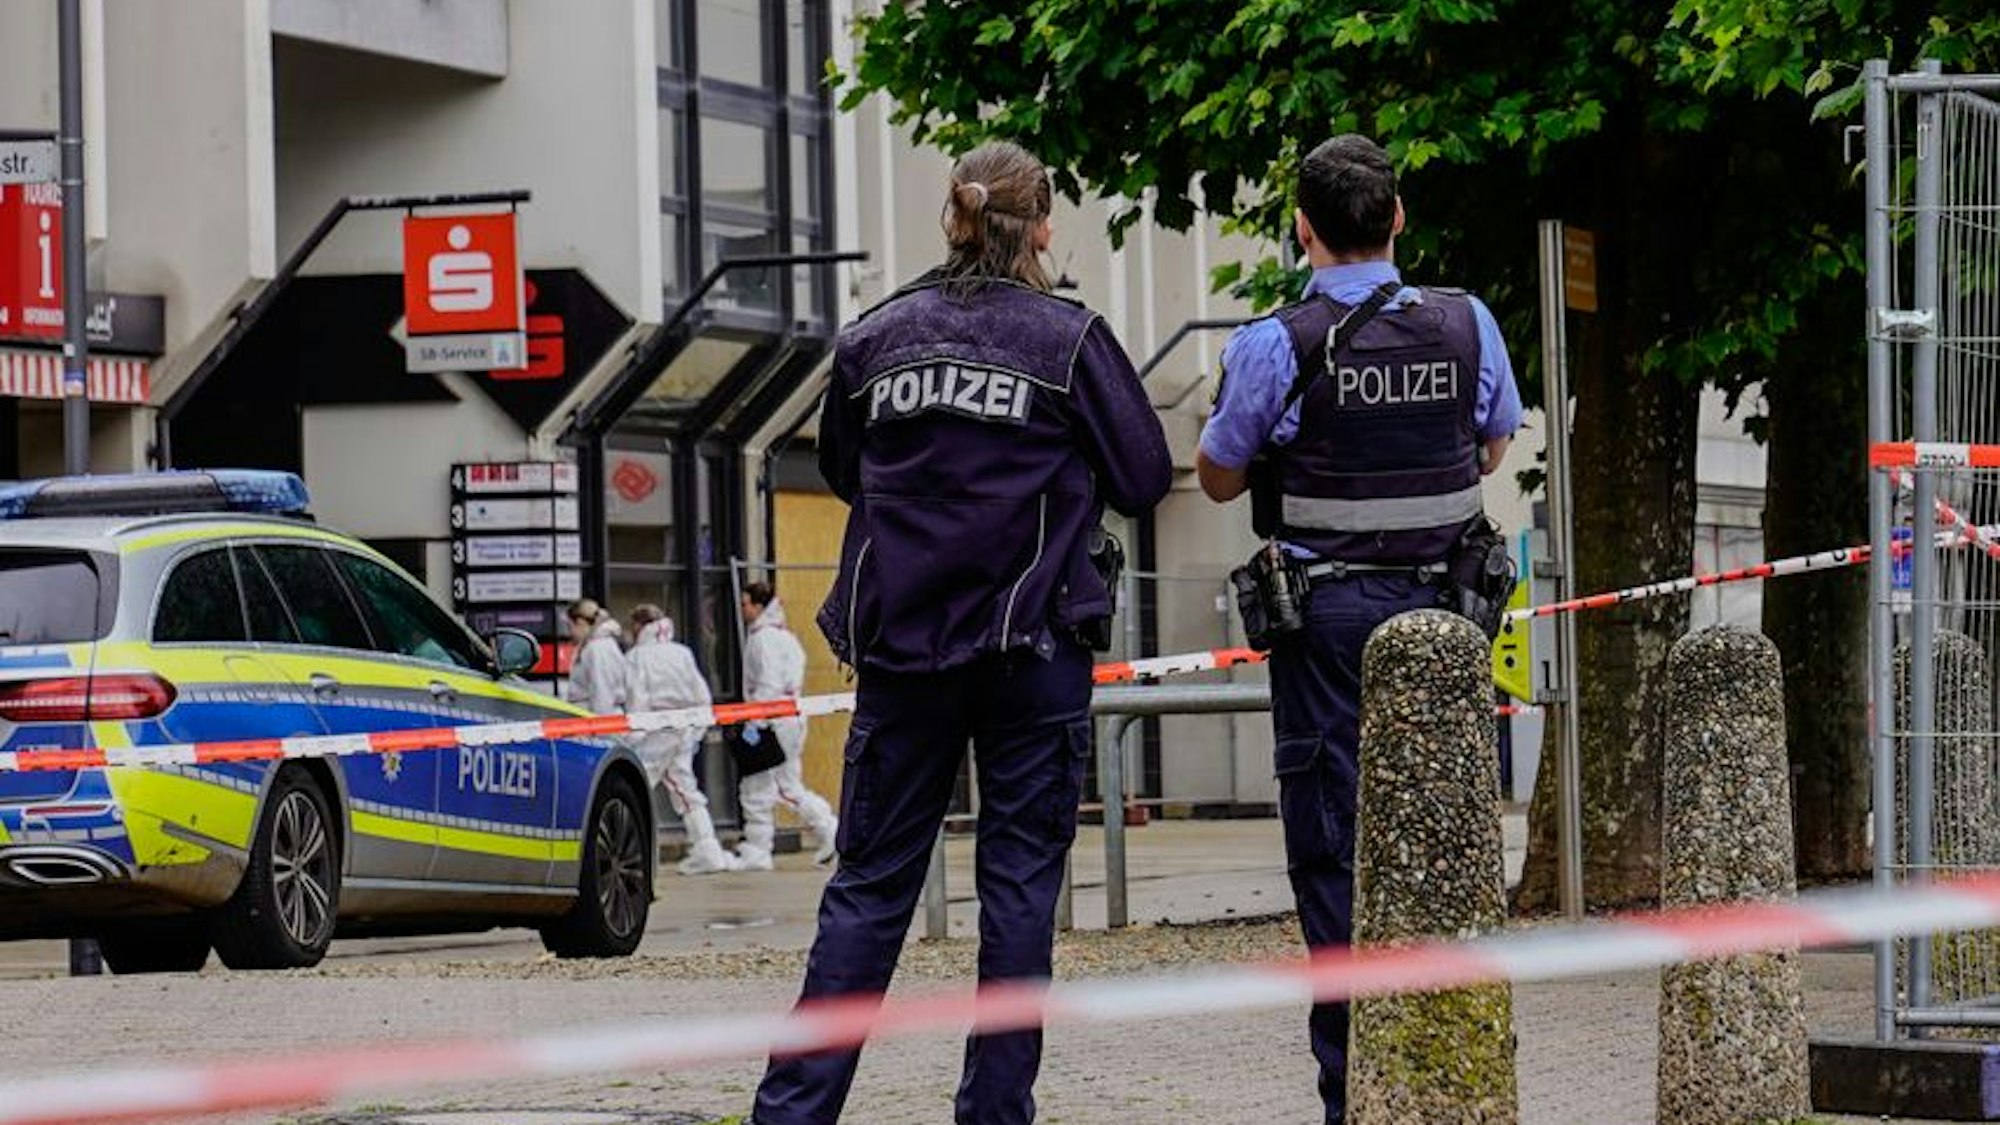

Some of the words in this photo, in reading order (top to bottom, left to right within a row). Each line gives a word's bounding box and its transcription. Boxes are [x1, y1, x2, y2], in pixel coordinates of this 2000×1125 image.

[0, 151, 35, 174] str.
[870, 364, 1030, 421] POLIZEI
[1337, 361, 1458, 406] POLIZEI
[452, 468, 463, 491] 4
[452, 504, 464, 528] 3
[453, 540, 465, 563] 3
[453, 577, 466, 599] 3
[458, 746, 537, 798] POLIZEI
